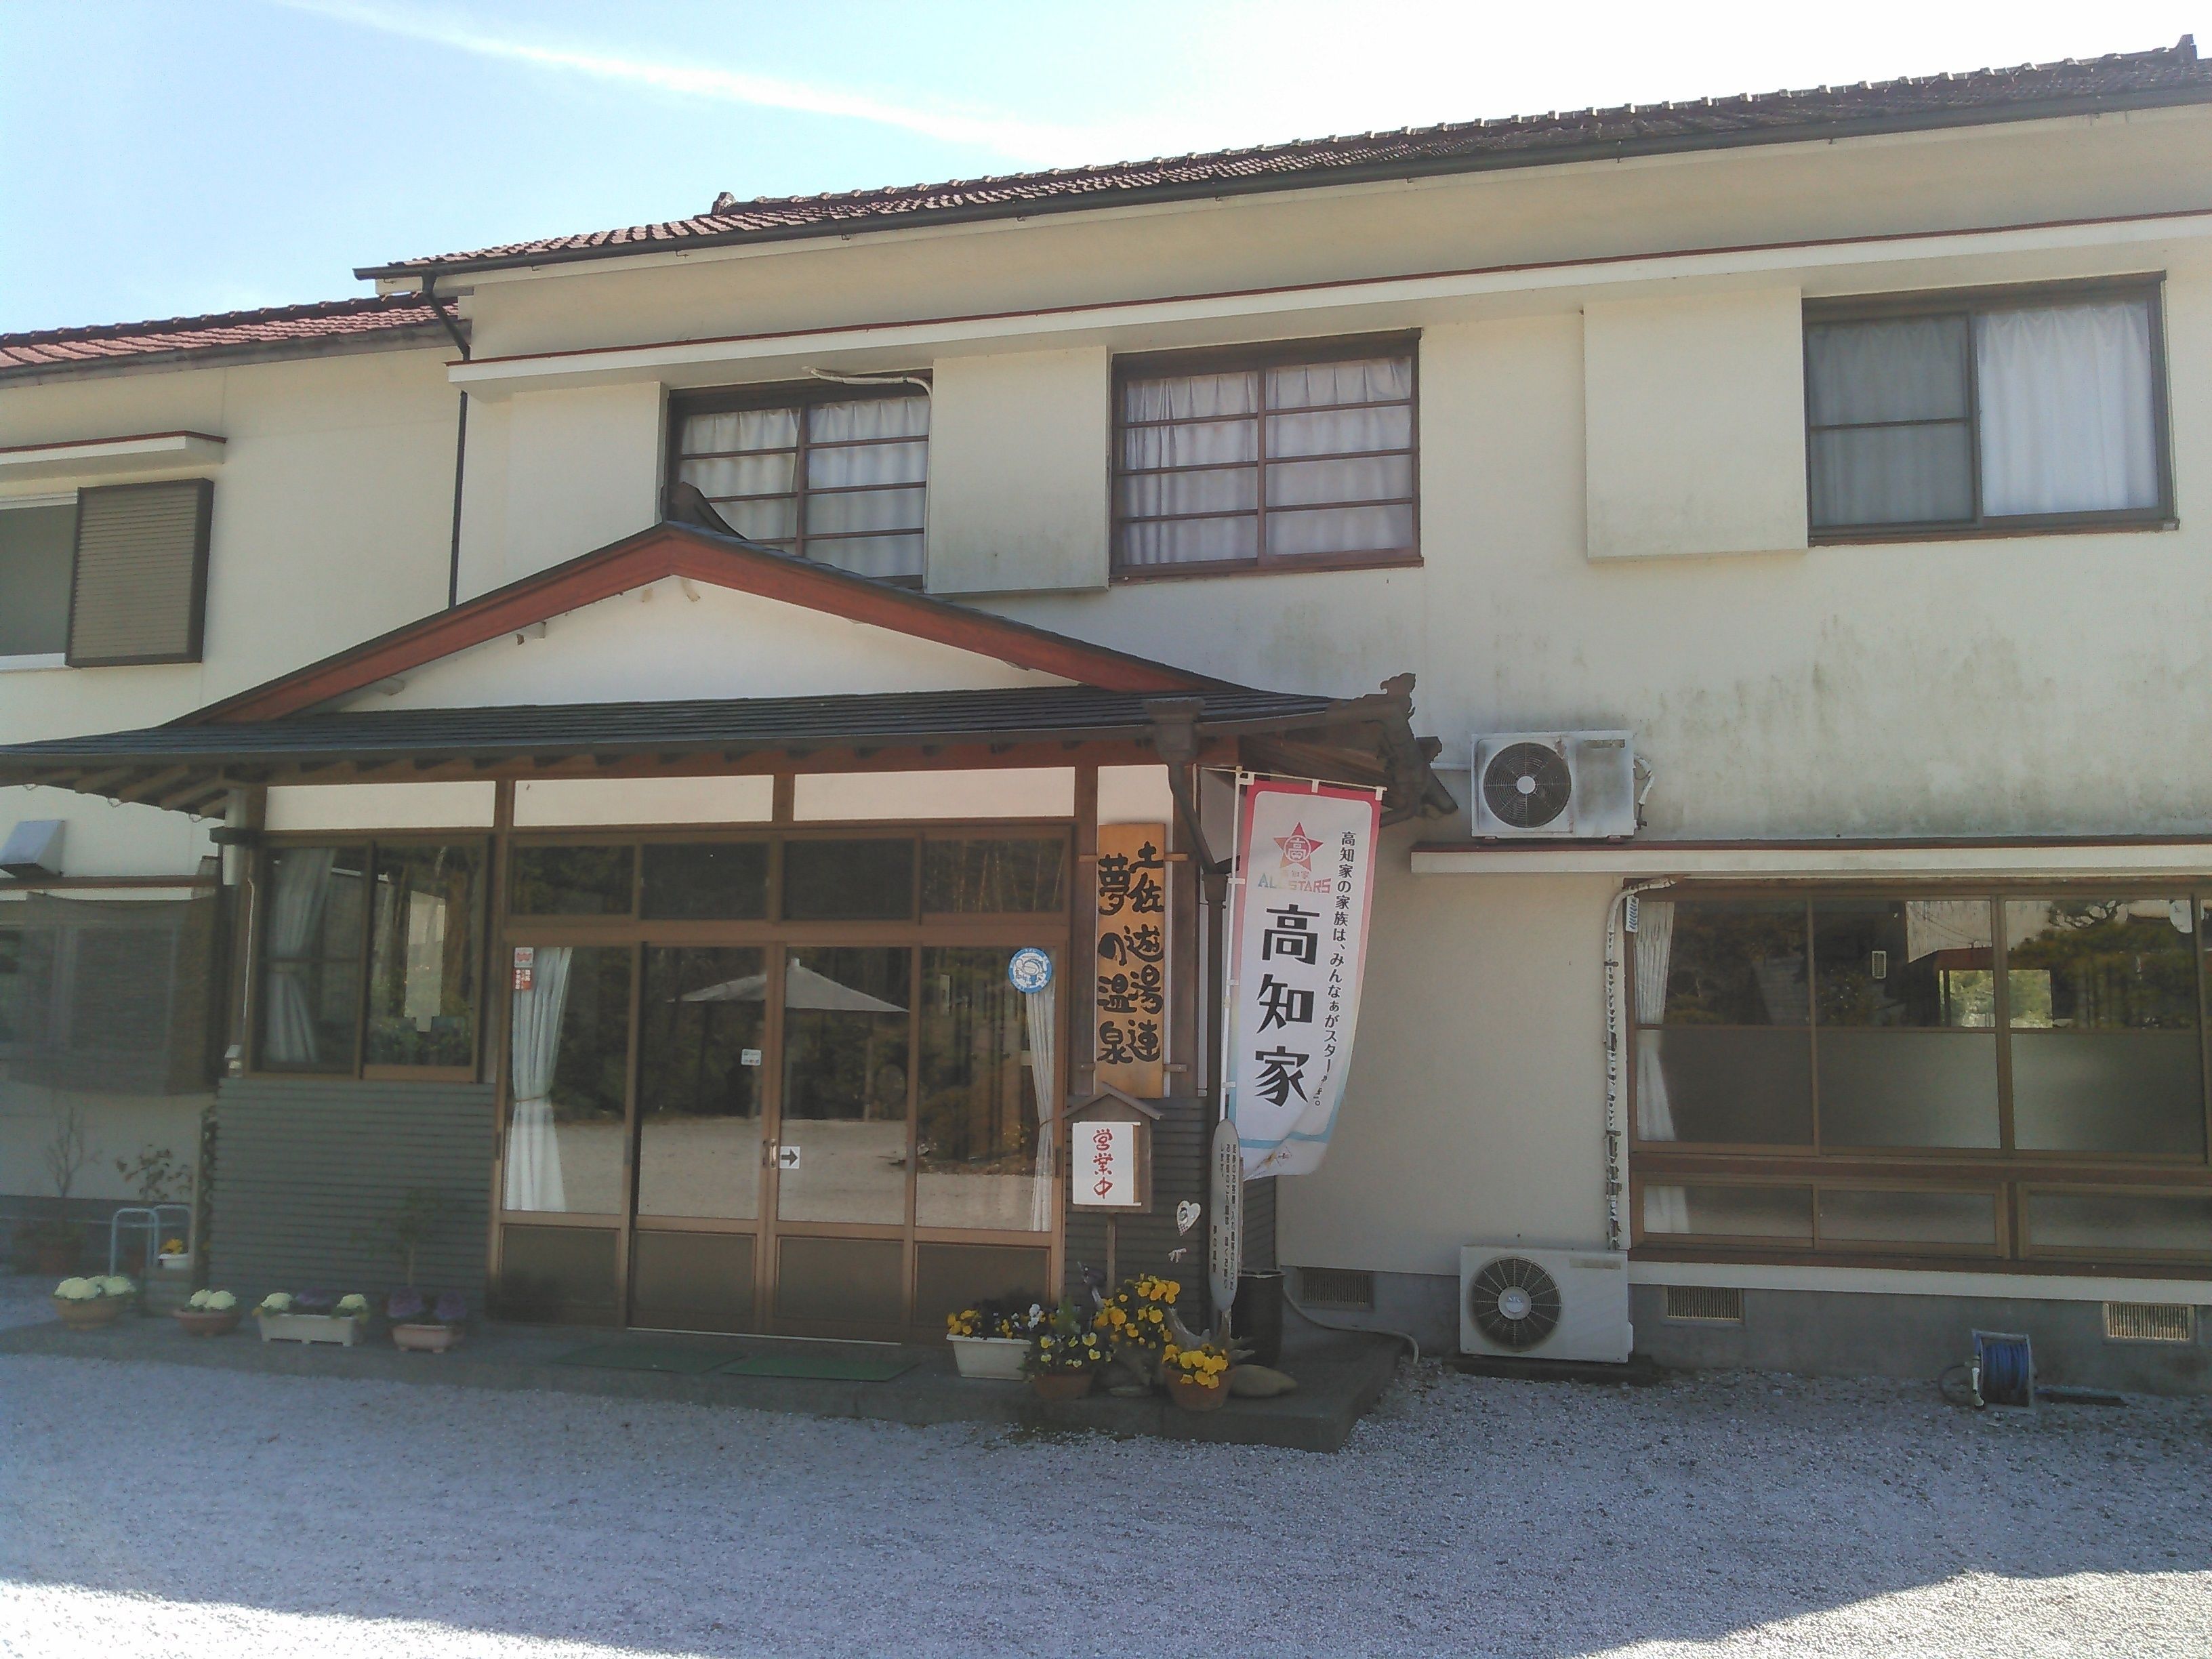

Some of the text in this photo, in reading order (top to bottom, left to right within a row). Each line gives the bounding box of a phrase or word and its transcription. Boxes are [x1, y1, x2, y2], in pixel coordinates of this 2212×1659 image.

[1258, 872, 1332, 894] AL STARS
[1097, 852, 1137, 1065] 夢の温泉
[1255, 903, 1320, 1107] 高知家
[1092, 1128, 1113, 1200] 営業中
